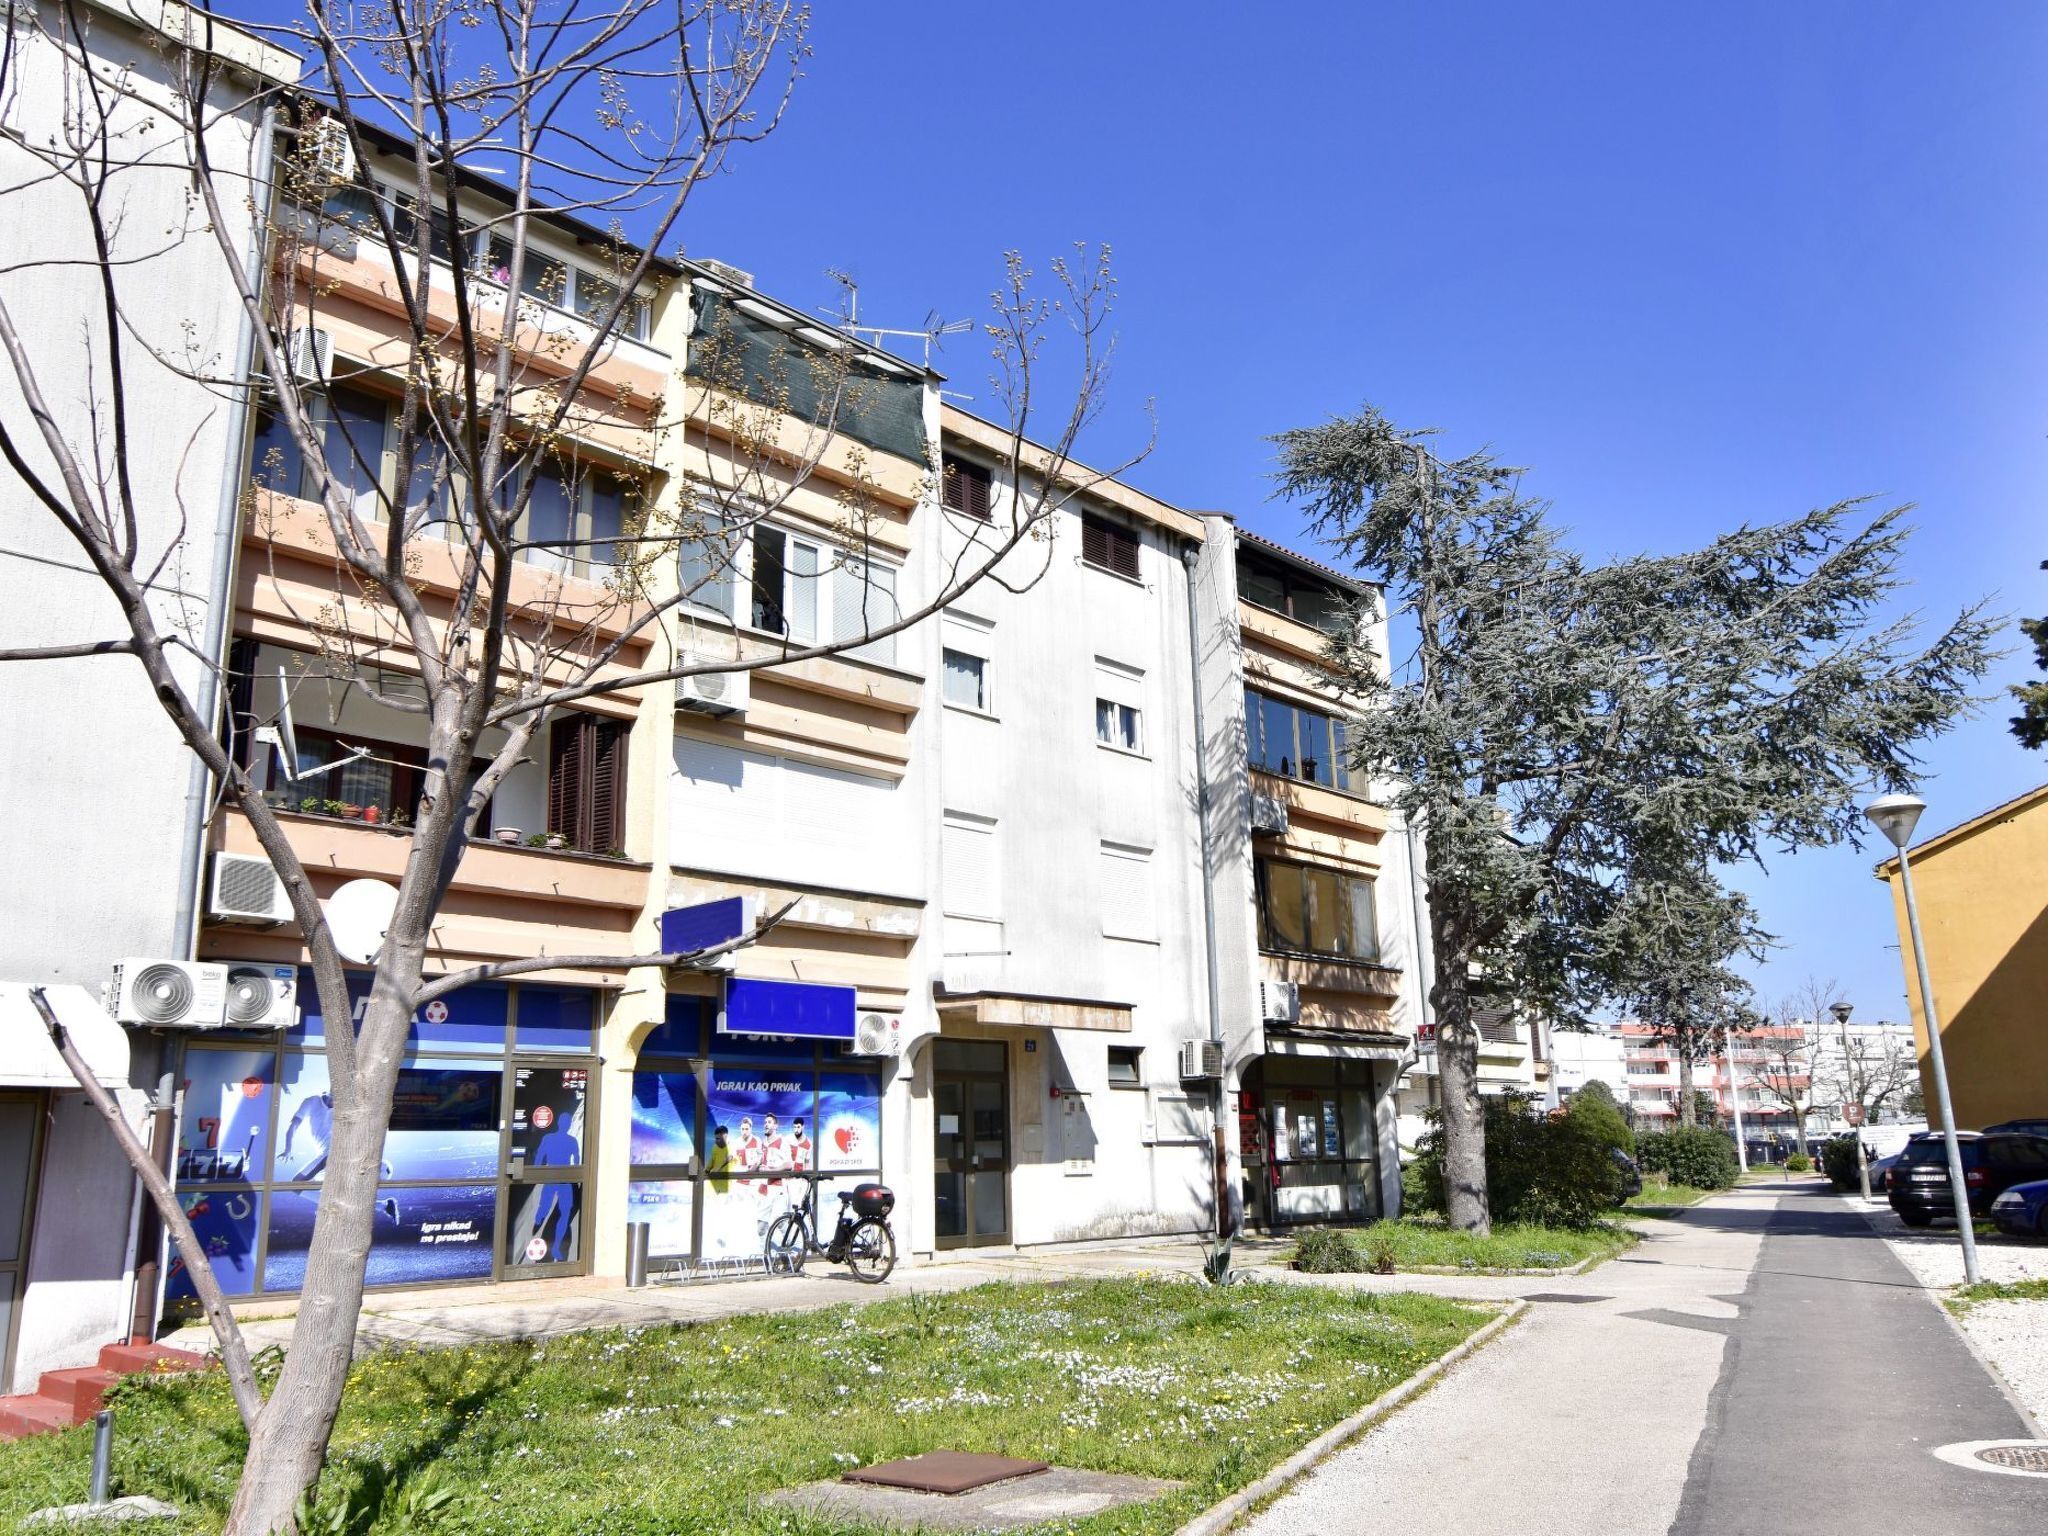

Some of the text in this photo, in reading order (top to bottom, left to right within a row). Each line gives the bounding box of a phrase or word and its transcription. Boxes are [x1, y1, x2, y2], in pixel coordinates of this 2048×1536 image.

[717, 1081, 802, 1092] IGRAJ KAO PRVAK
[421, 1221, 472, 1233] Igra nikad
[434, 1231, 480, 1244] prestaje!
